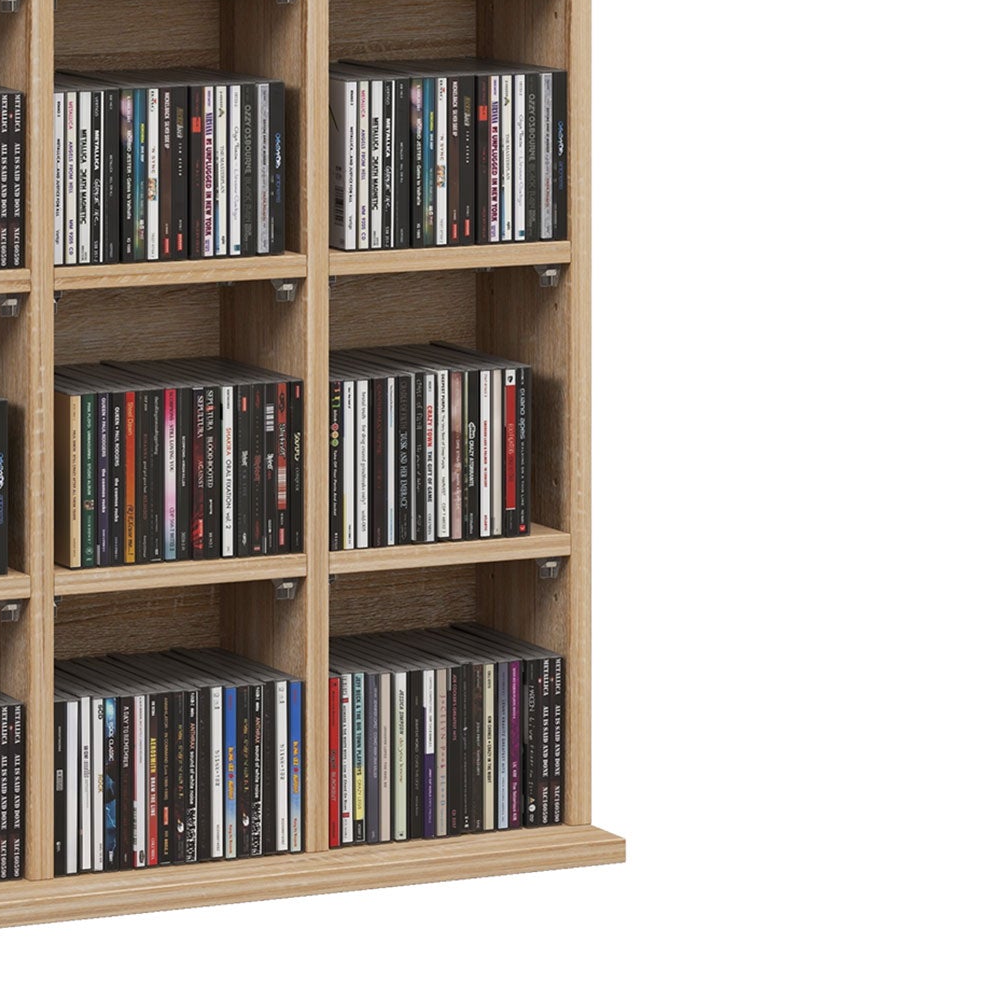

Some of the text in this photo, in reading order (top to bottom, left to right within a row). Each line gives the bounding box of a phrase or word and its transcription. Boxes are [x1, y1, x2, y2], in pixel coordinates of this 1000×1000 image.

[205, 191, 212, 199] IN
[427, 477, 433, 485] OF
[555, 717, 561, 725] IS
[14, 767, 21, 775] IS
